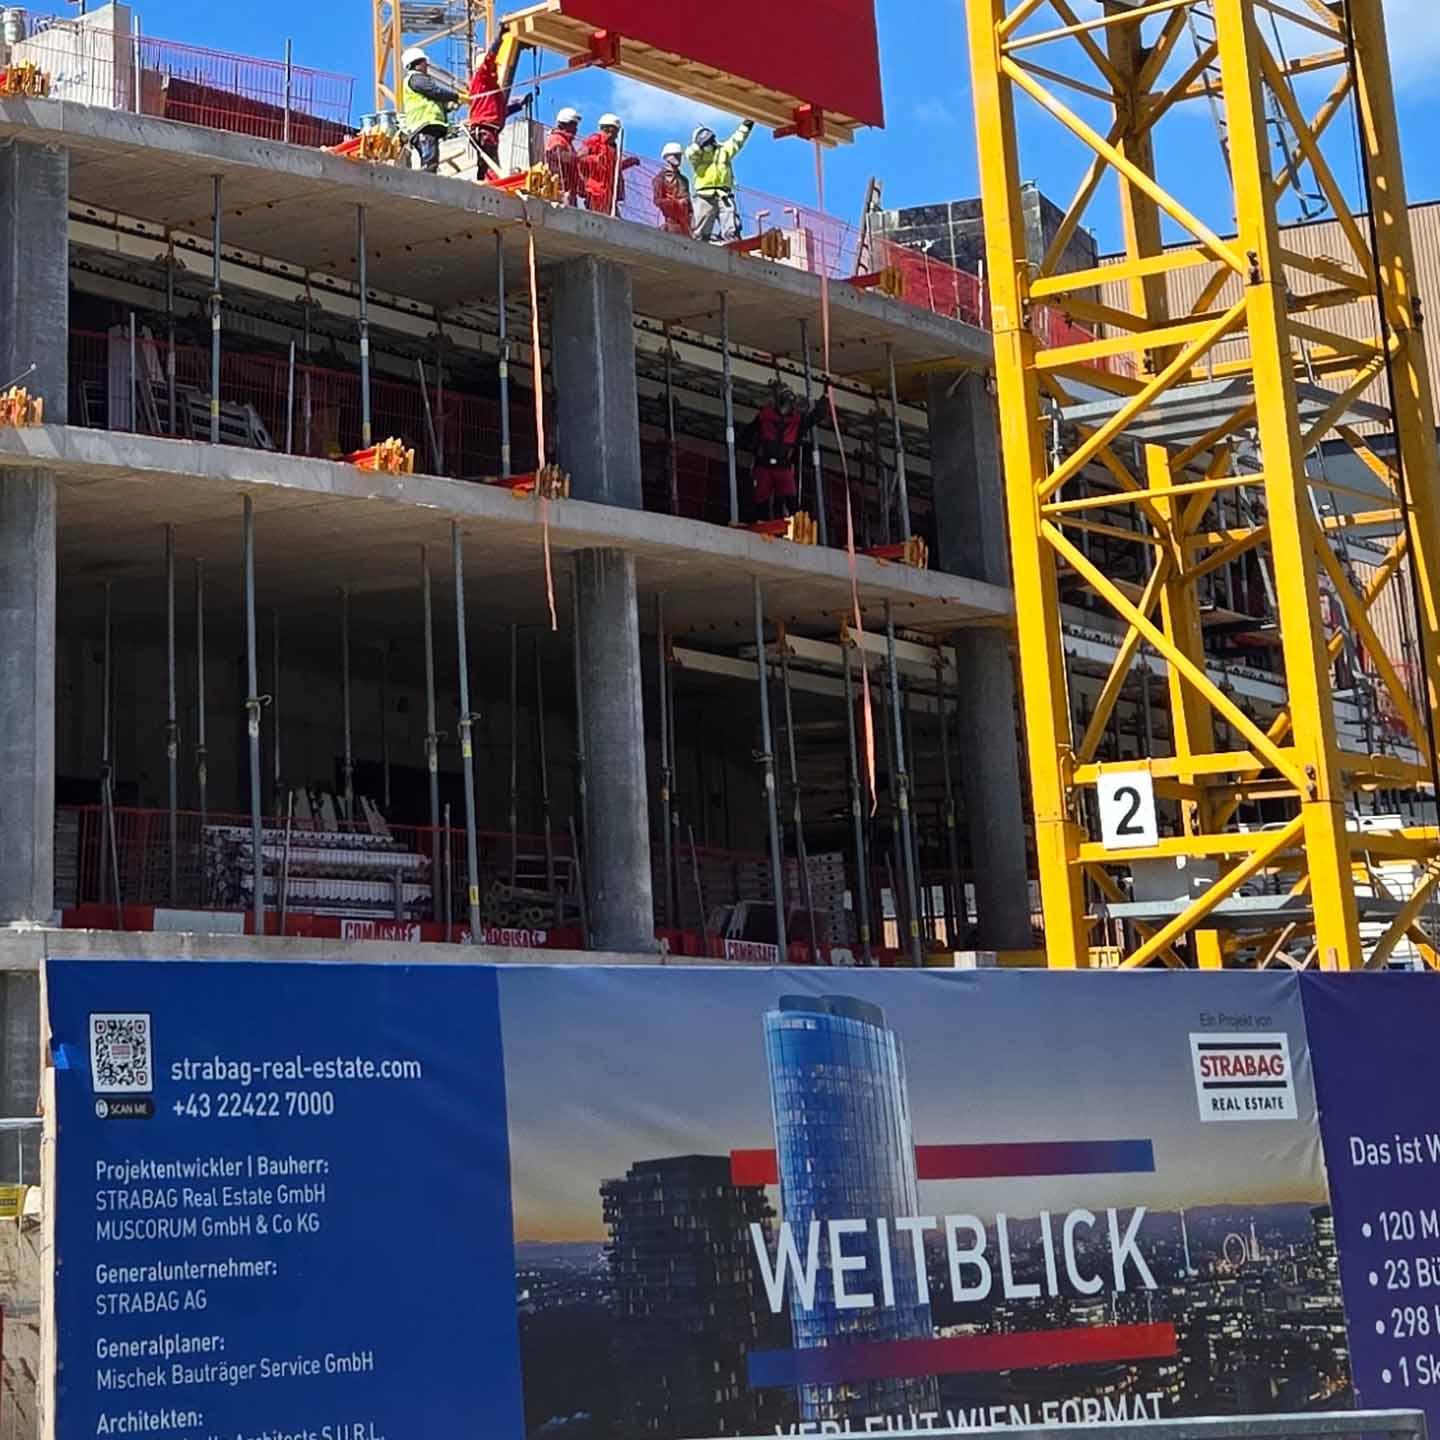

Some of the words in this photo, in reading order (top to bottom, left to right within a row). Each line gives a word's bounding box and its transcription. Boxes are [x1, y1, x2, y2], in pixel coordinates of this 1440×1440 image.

[1113, 786, 1145, 836] 2
[1199, 1012, 1216, 1026] Ein
[171, 1056, 421, 1085] strabag-real-estate.com
[1200, 1055, 1284, 1077] STRABAG
[110, 1103, 132, 1114] SCAN
[134, 1103, 147, 1113] ME
[173, 1093, 210, 1118] +43
[217, 1092, 280, 1117] 22422
[285, 1091, 334, 1116] 7000
[1211, 1097, 1241, 1111] REAL
[1244, 1096, 1284, 1110] ESTATE
[1350, 1136, 1391, 1166] Das
[1395, 1133, 1423, 1164] ist
[95, 1158, 243, 1182] Projektentwickler
[257, 1156, 329, 1177] Bauherr:
[95, 1188, 178, 1211] STRABAG
[183, 1187, 218, 1208] Real
[222, 1185, 273, 1207] Estate
[277, 1183, 326, 1205] GmbH
[95, 1218, 197, 1241] MUSCORUM
[202, 1216, 251, 1238] GmbH
[256, 1216, 269, 1235] &
[272, 1215, 293, 1234] Co
[297, 1213, 320, 1233] KG
[1379, 1210, 1415, 1241] 120
[95, 1258, 277, 1285] Generalunternehmer:
[750, 1206, 1158, 1313] WEITBLICK
[1384, 1259, 1410, 1289] 23
[95, 1291, 179, 1315] STRABAG
[184, 1289, 208, 1311] AG
[1391, 1306, 1430, 1338] 298
[95, 1334, 225, 1359] Generalplaner:
[96, 1366, 167, 1391] Mischek
[172, 1361, 257, 1386] Bauträger
[260, 1357, 321, 1379] Service
[324, 1352, 375, 1373] GmbH
[1398, 1357, 1410, 1388] 1
[96, 1407, 204, 1435] Architekten:
